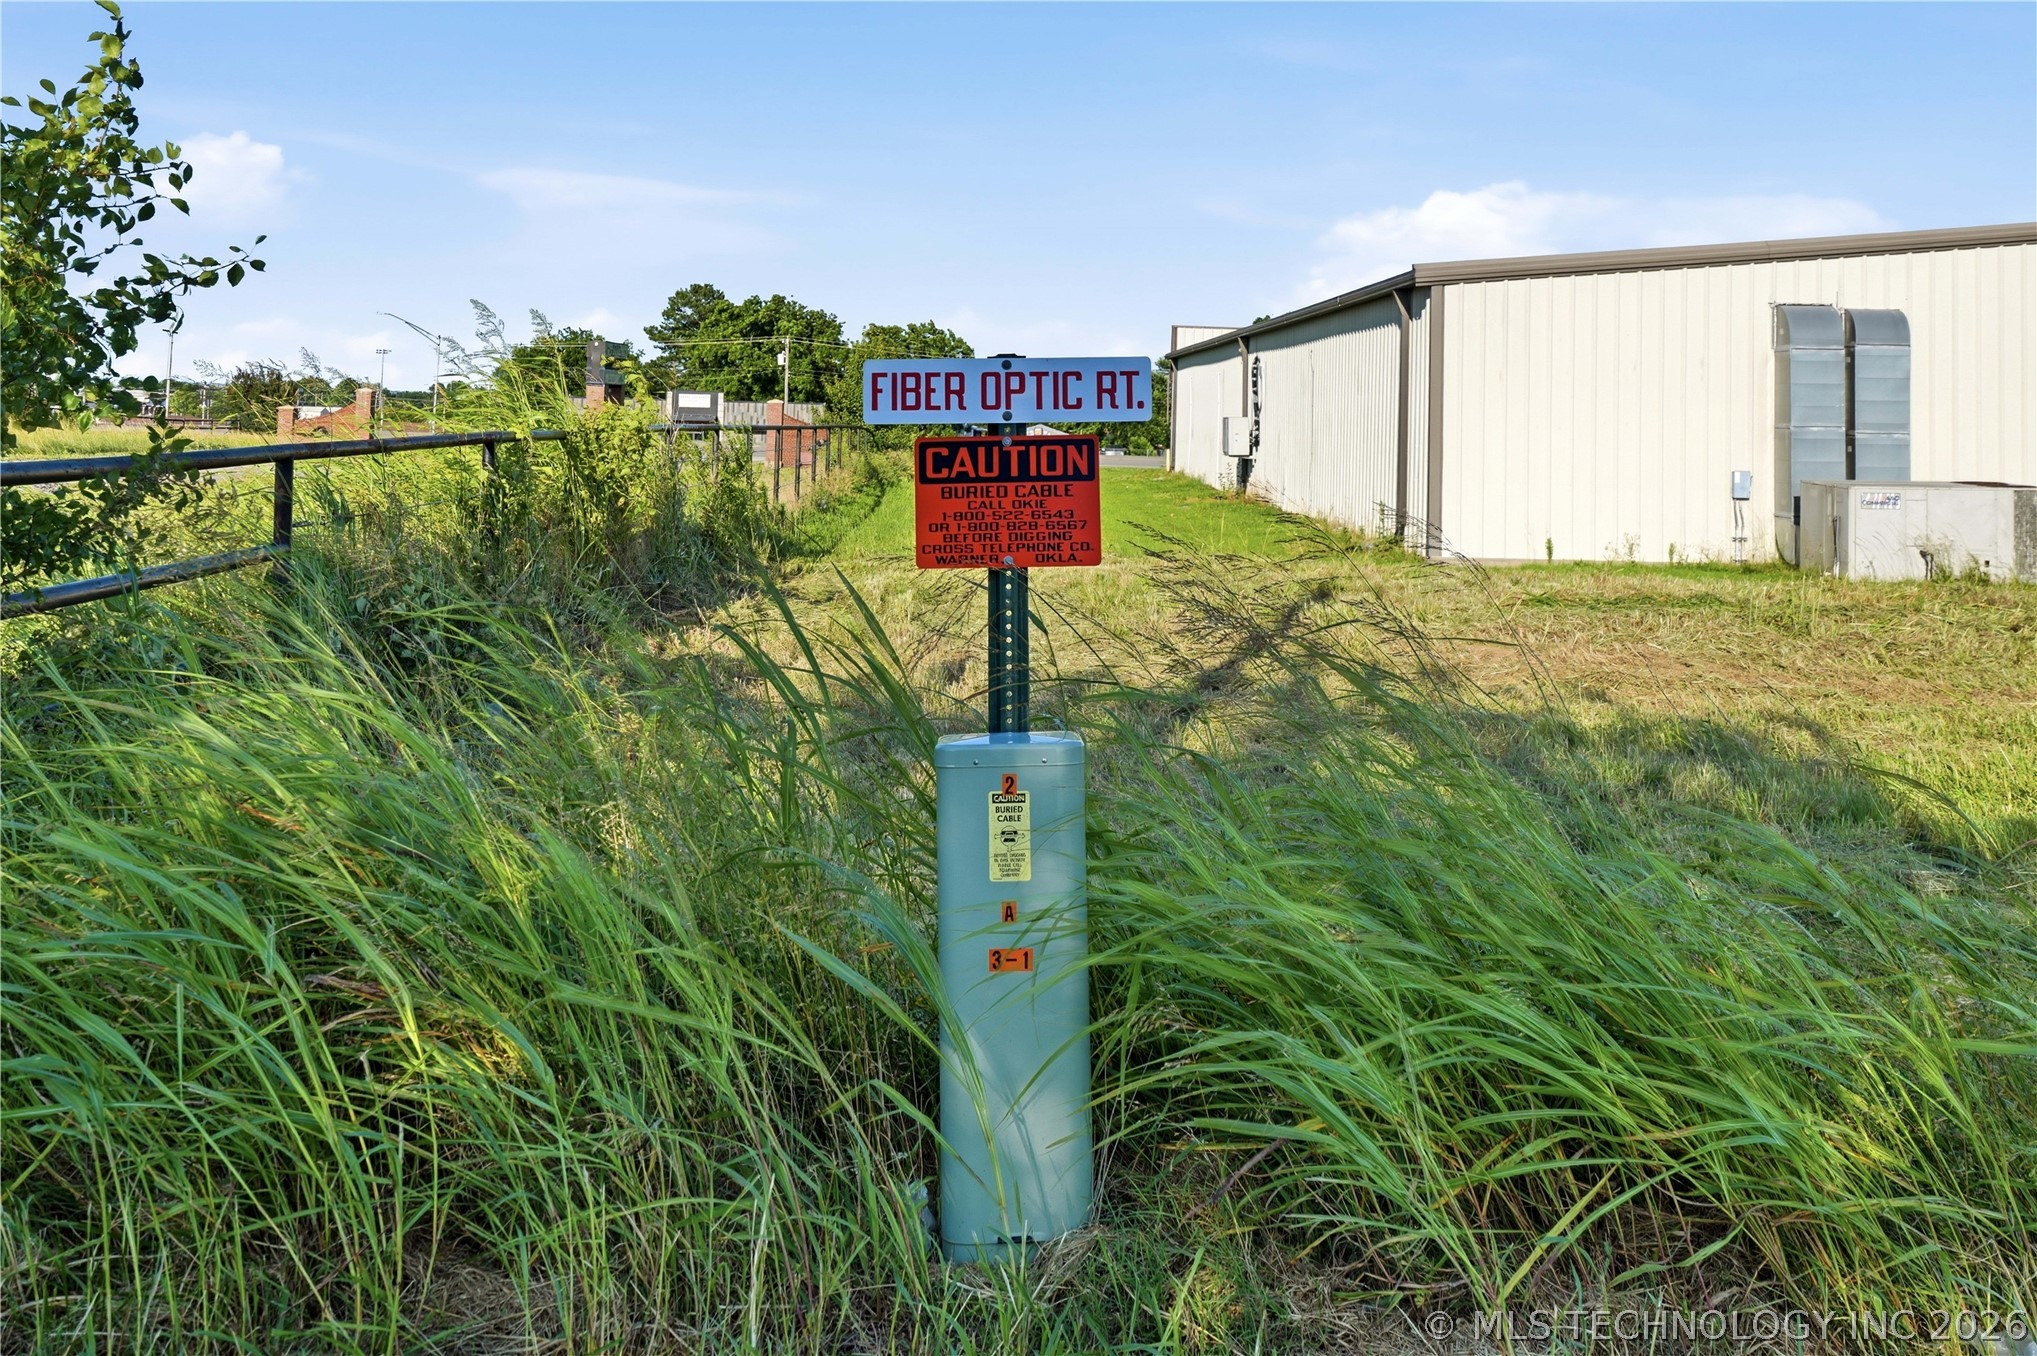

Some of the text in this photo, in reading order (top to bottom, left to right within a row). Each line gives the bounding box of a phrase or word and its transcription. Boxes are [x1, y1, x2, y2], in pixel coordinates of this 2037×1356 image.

[871, 370, 1145, 411] FIBER OPTIC RT.
[925, 444, 1089, 479] CAUTION
[941, 484, 1074, 499] BURIED CABLE
[967, 499, 1047, 510] CALL OKIE
[942, 509, 1074, 521] 1-800-522-6543
[928, 520, 1088, 533] OR 1-800-828-6567
[943, 531, 1073, 543] BEFORE DIGGING
[921, 541, 1095, 555] CROSS TELEPHONE CO.
[1035, 553, 1083, 563] OKLA.
[1004, 776, 1015, 795] 2
[993, 794, 1025, 803] CAUTION
[995, 806, 1024, 814] BURIED
[1004, 905, 1014, 922] A
[992, 950, 1029, 970] 3-1
